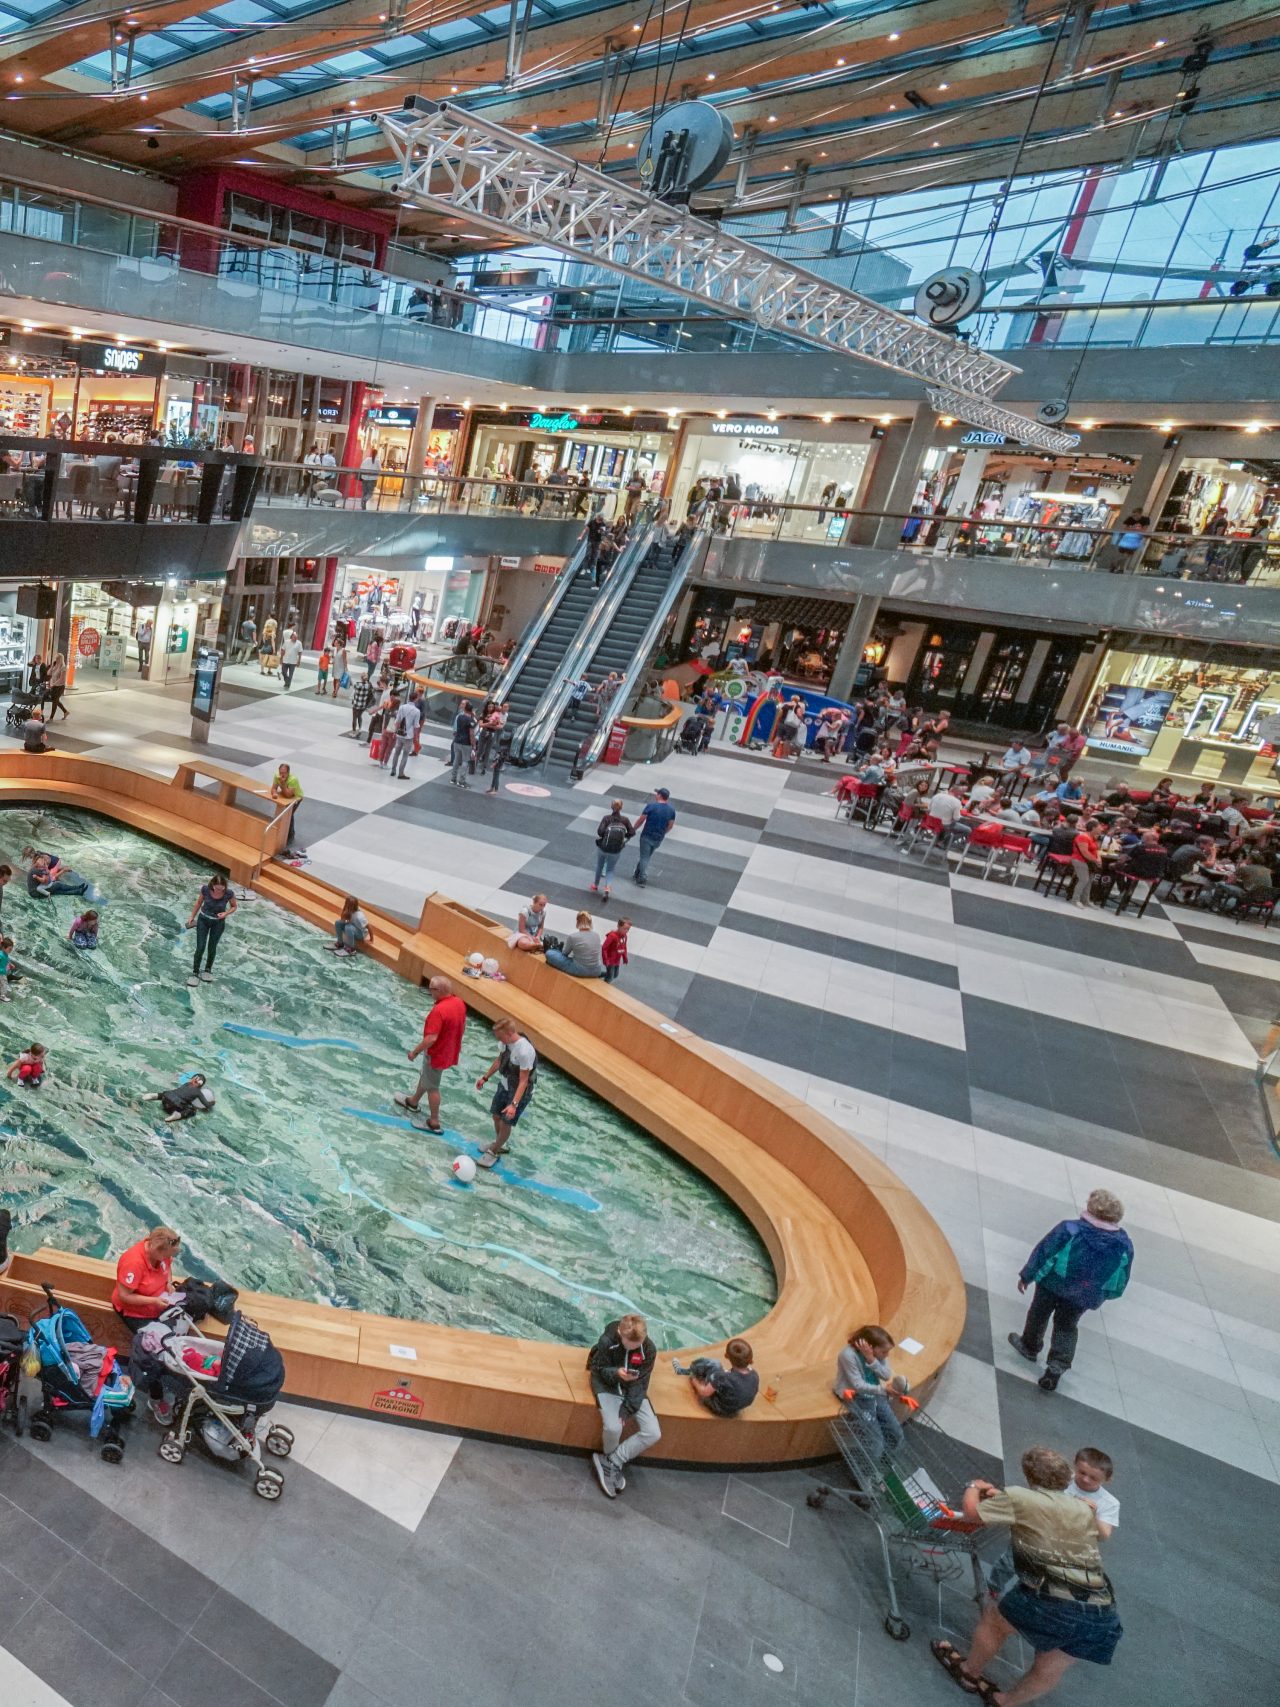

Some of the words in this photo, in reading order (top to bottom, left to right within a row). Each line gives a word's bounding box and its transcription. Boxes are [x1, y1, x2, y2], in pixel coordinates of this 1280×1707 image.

[104, 348, 139, 371] snipes
[712, 423, 742, 434] VERO
[744, 425, 779, 435] MODA
[961, 431, 1006, 445] JACK
[1099, 741, 1135, 753] HUMANIC
[125, 1272, 135, 1285] 3
[374, 1401, 419, 1415] CHARGING
